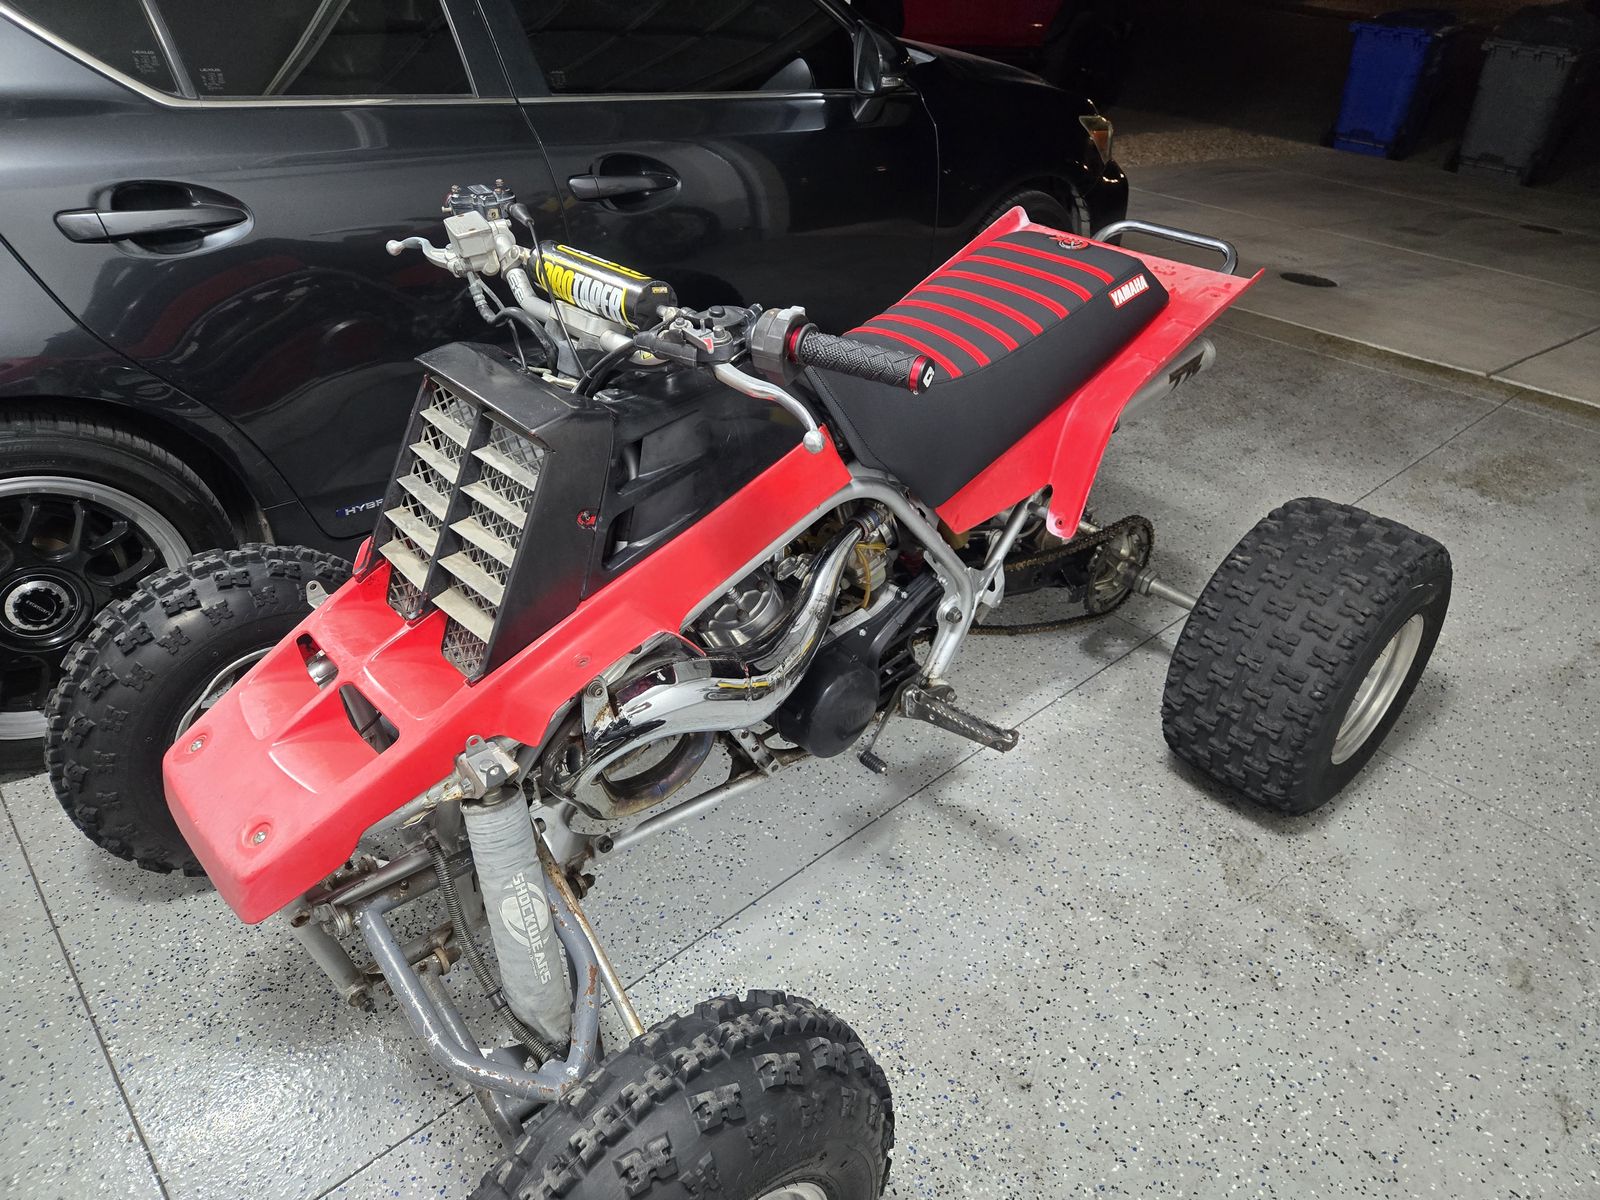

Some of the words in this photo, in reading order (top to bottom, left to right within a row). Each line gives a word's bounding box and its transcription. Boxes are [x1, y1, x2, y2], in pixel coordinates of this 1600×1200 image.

[1110, 275, 1149, 306] YAMAHA
[344, 498, 384, 516] HYBR
[512, 871, 551, 985] SHOCKWEARS
